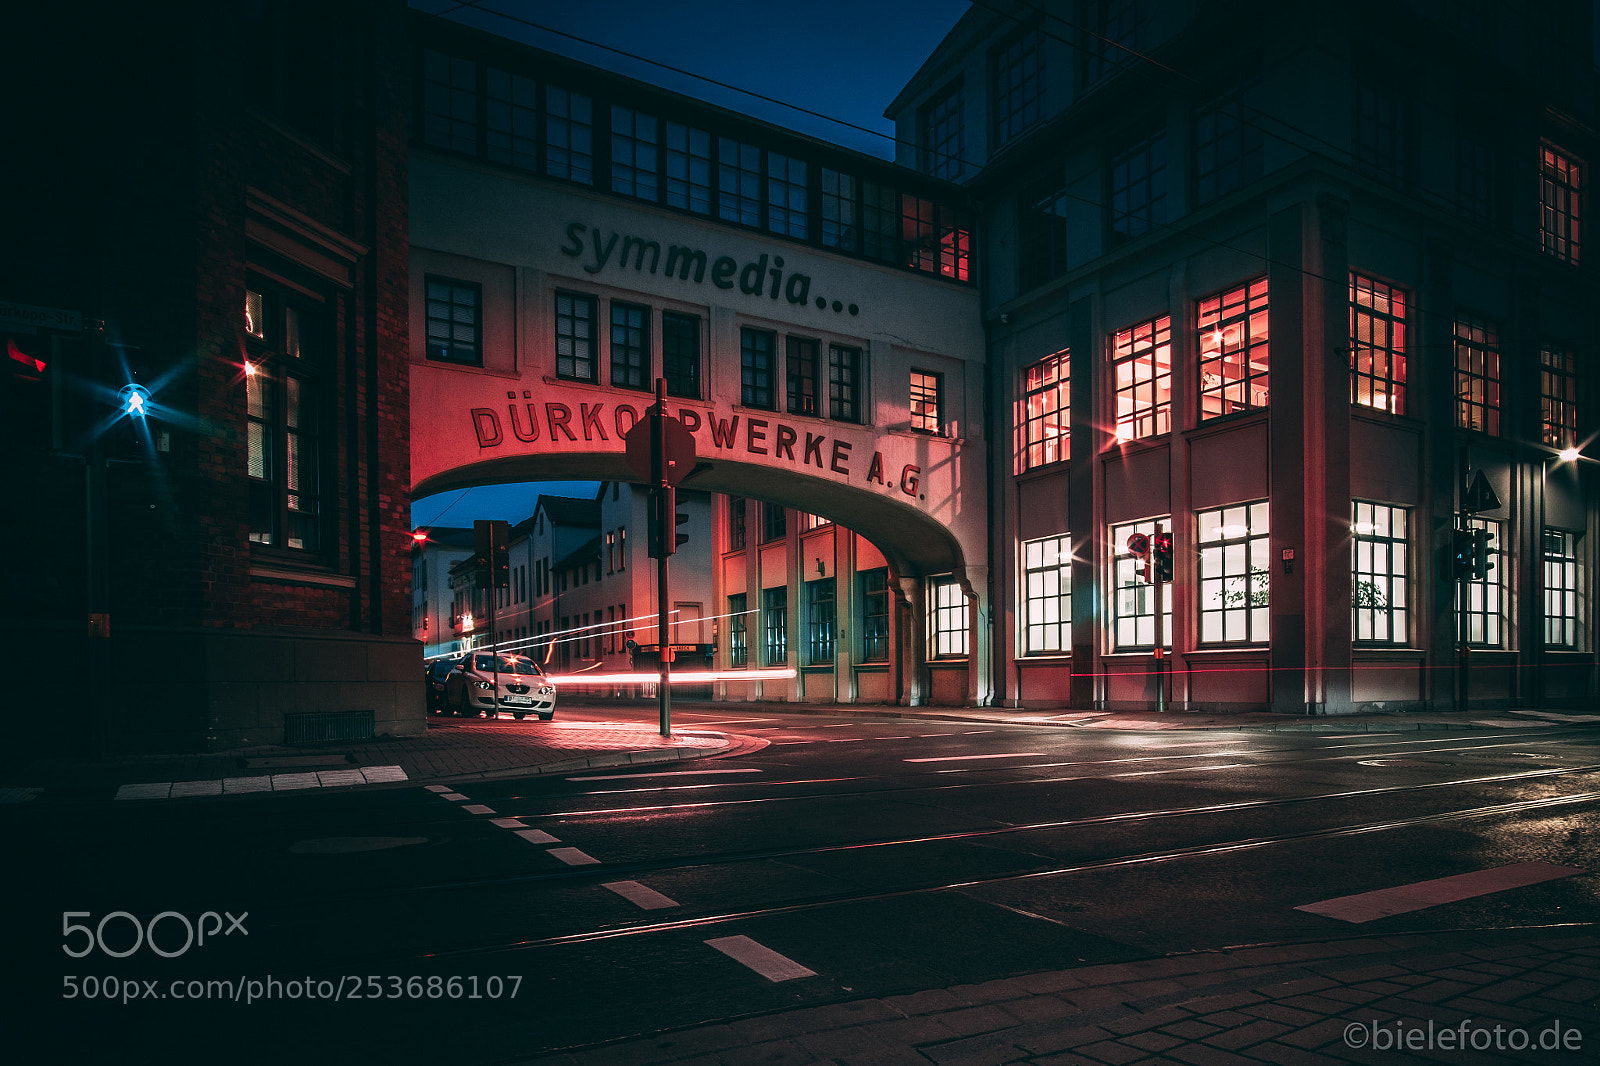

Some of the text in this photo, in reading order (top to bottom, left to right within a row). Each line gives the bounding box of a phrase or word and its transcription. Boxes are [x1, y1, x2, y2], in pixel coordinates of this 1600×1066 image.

[561, 222, 860, 316] symmedia...
[470, 390, 925, 501] DÜRKOPWERKE A.G.
